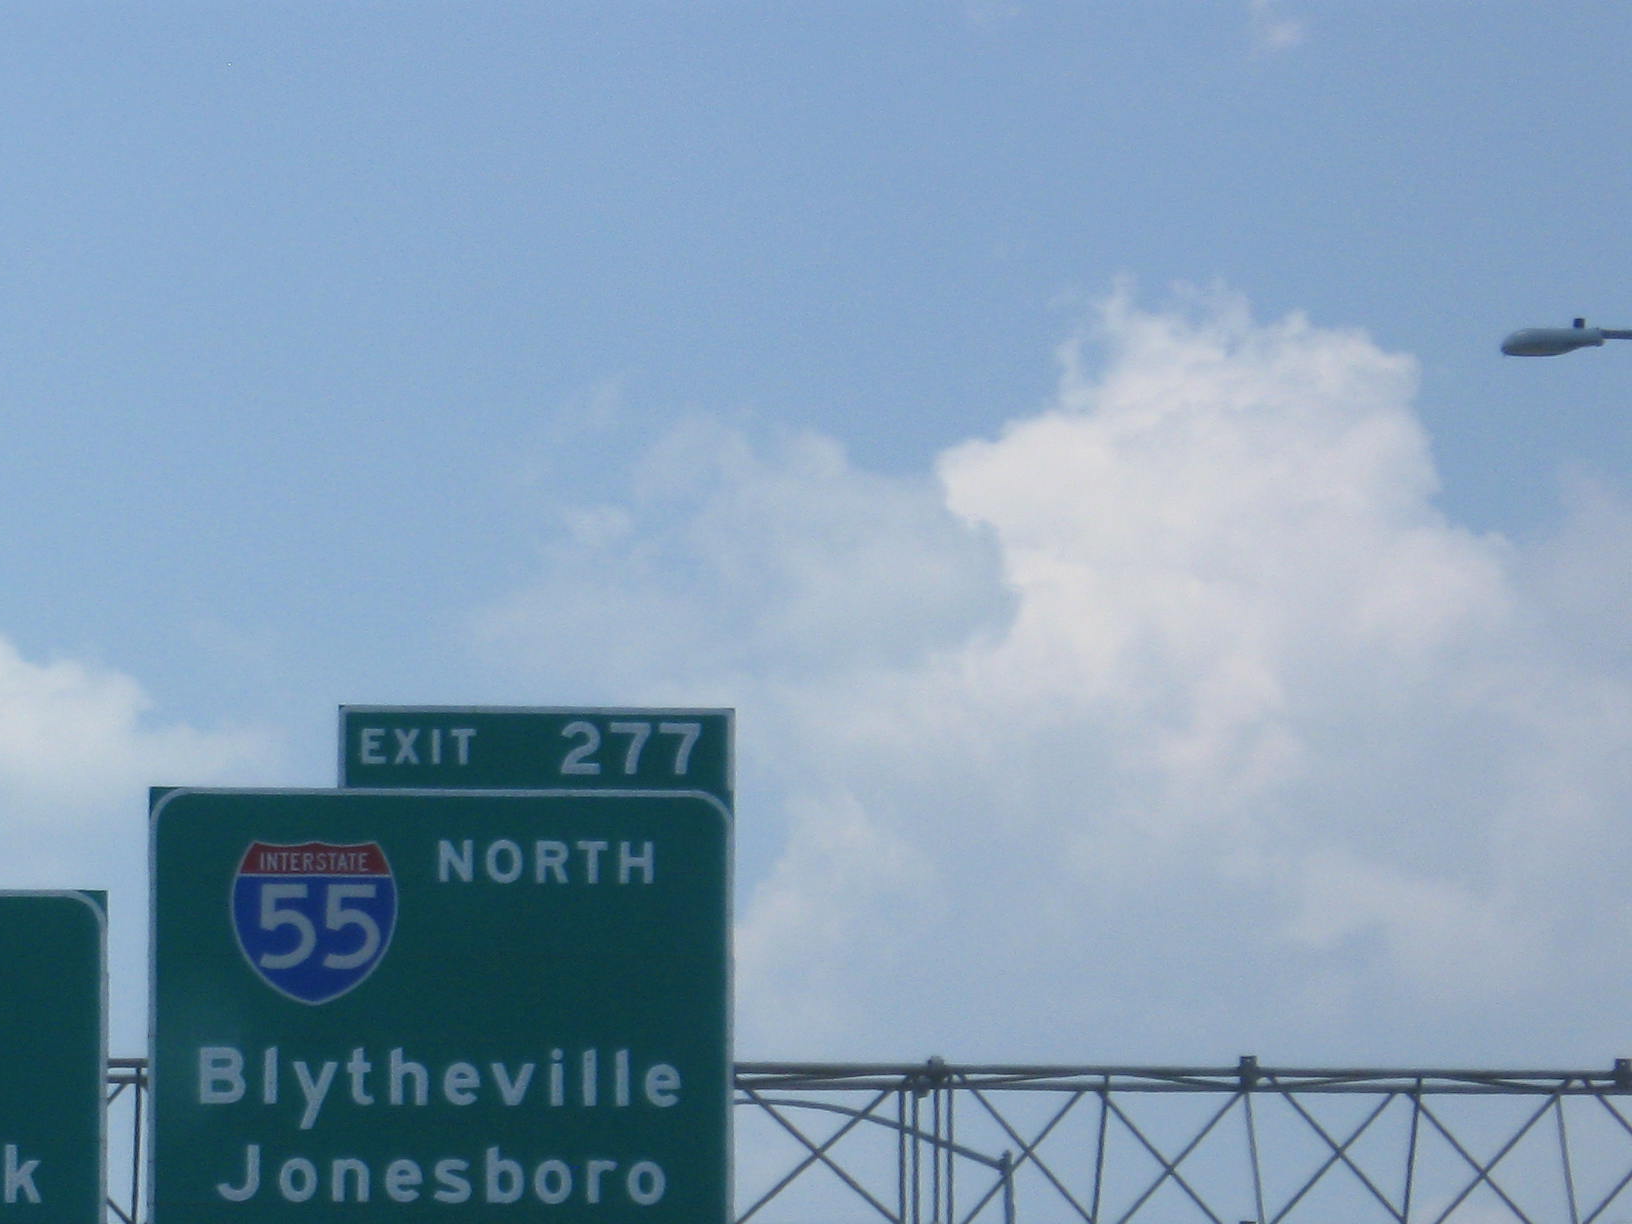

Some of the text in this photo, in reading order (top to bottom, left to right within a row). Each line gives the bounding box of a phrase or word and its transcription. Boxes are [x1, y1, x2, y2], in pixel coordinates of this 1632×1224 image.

[358, 721, 701, 775] EXIT 277
[259, 851, 369, 873] INTERSTATE
[438, 838, 654, 884] NORTH
[259, 883, 380, 970] 55
[197, 1045, 681, 1130] Blytheville
[216, 1144, 666, 1205] Jonesboro
